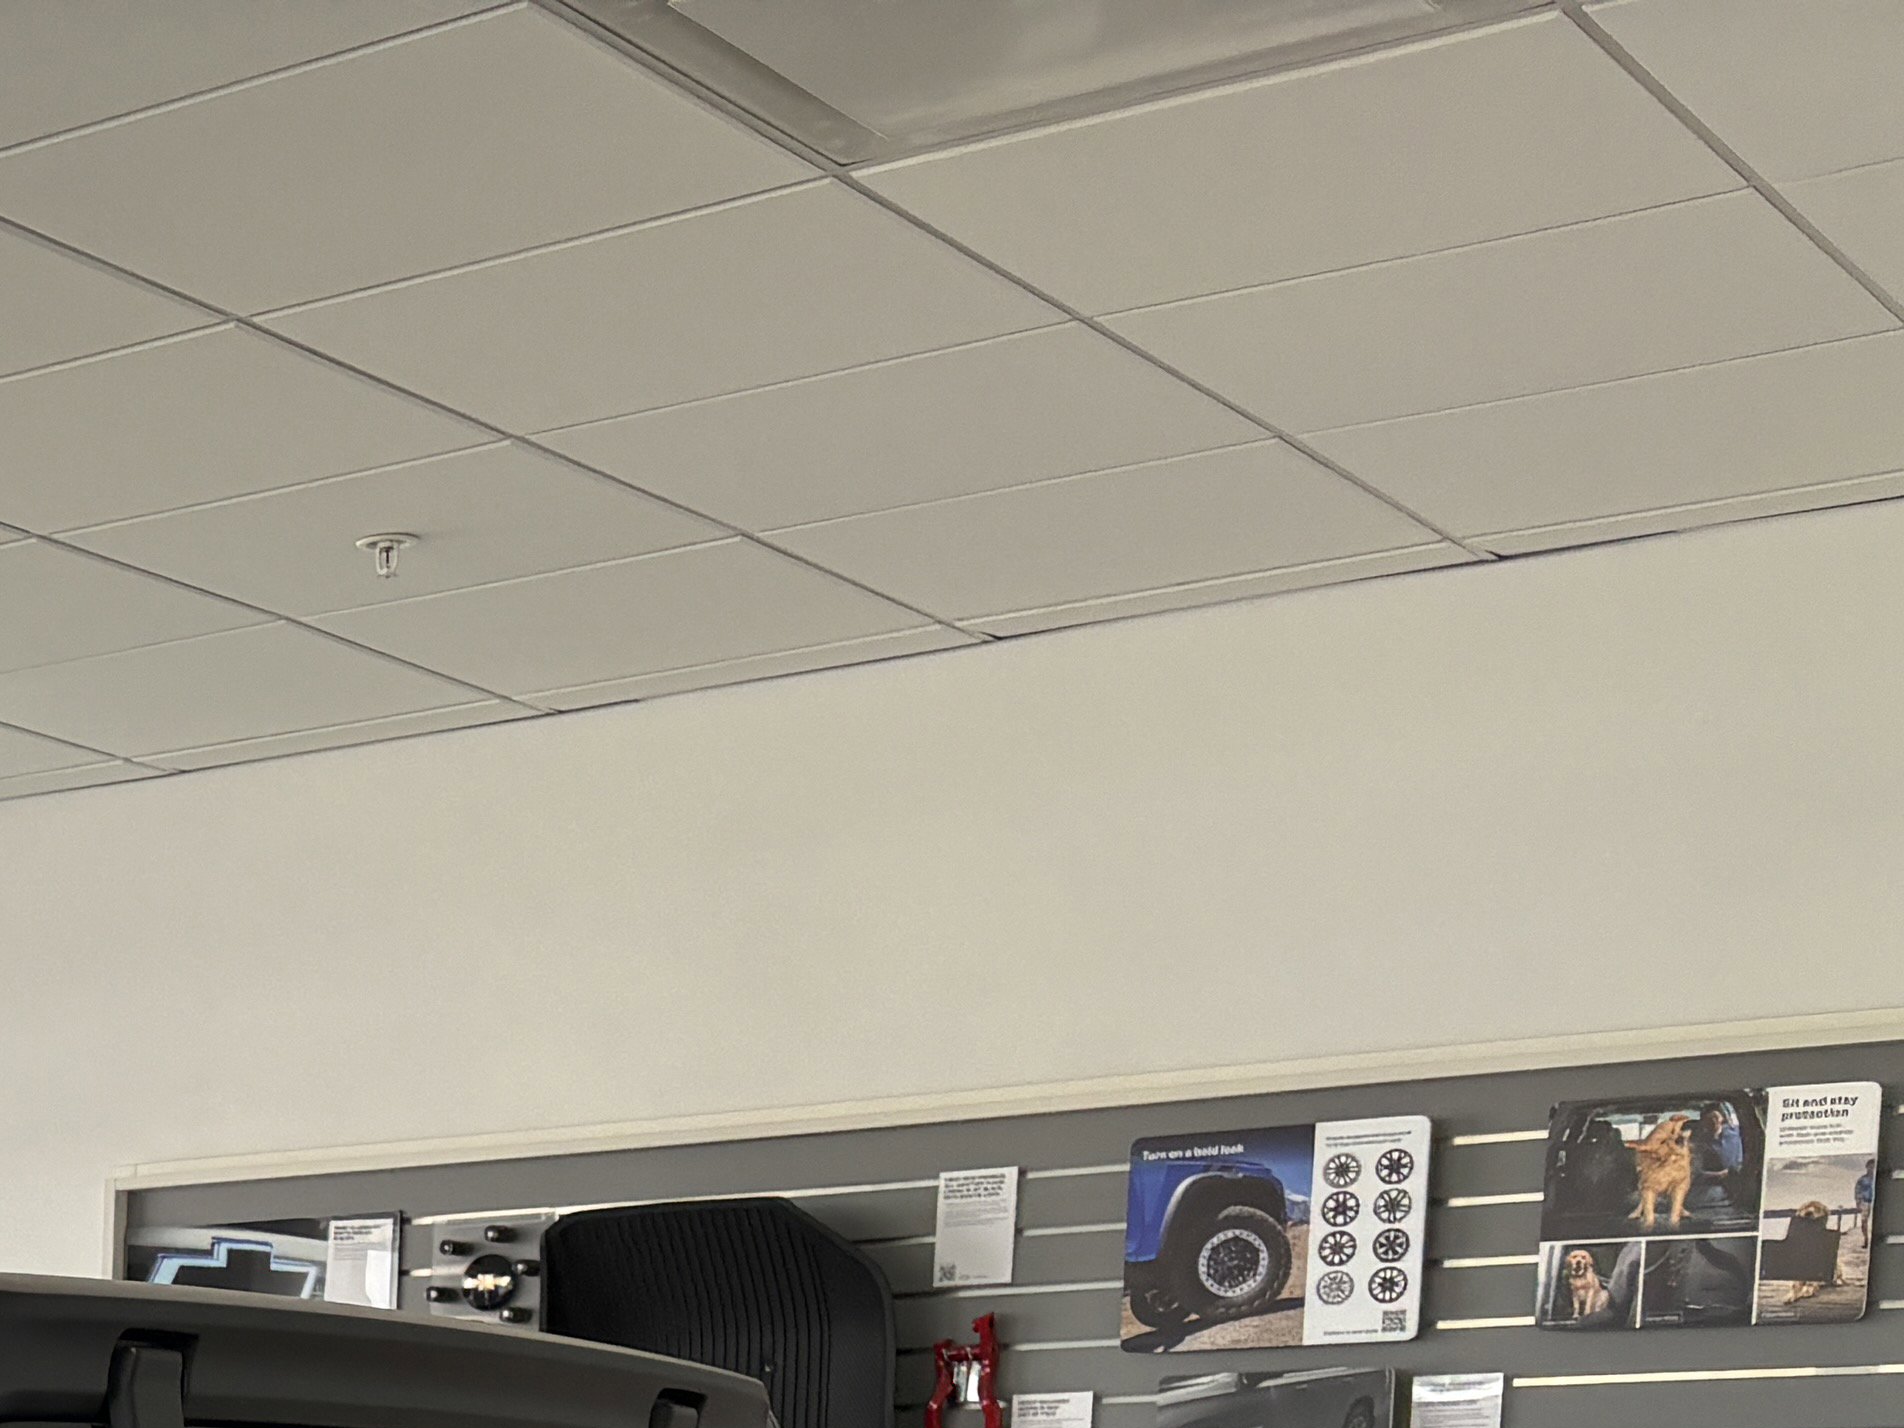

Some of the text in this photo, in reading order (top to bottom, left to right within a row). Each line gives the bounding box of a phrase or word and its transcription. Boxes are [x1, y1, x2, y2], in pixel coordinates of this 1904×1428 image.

[1803, 1096, 1828, 1108] and
[1830, 1096, 1859, 1107] stay
[1142, 1150, 1167, 1160] Turn
[1168, 1150, 1183, 1158] on
